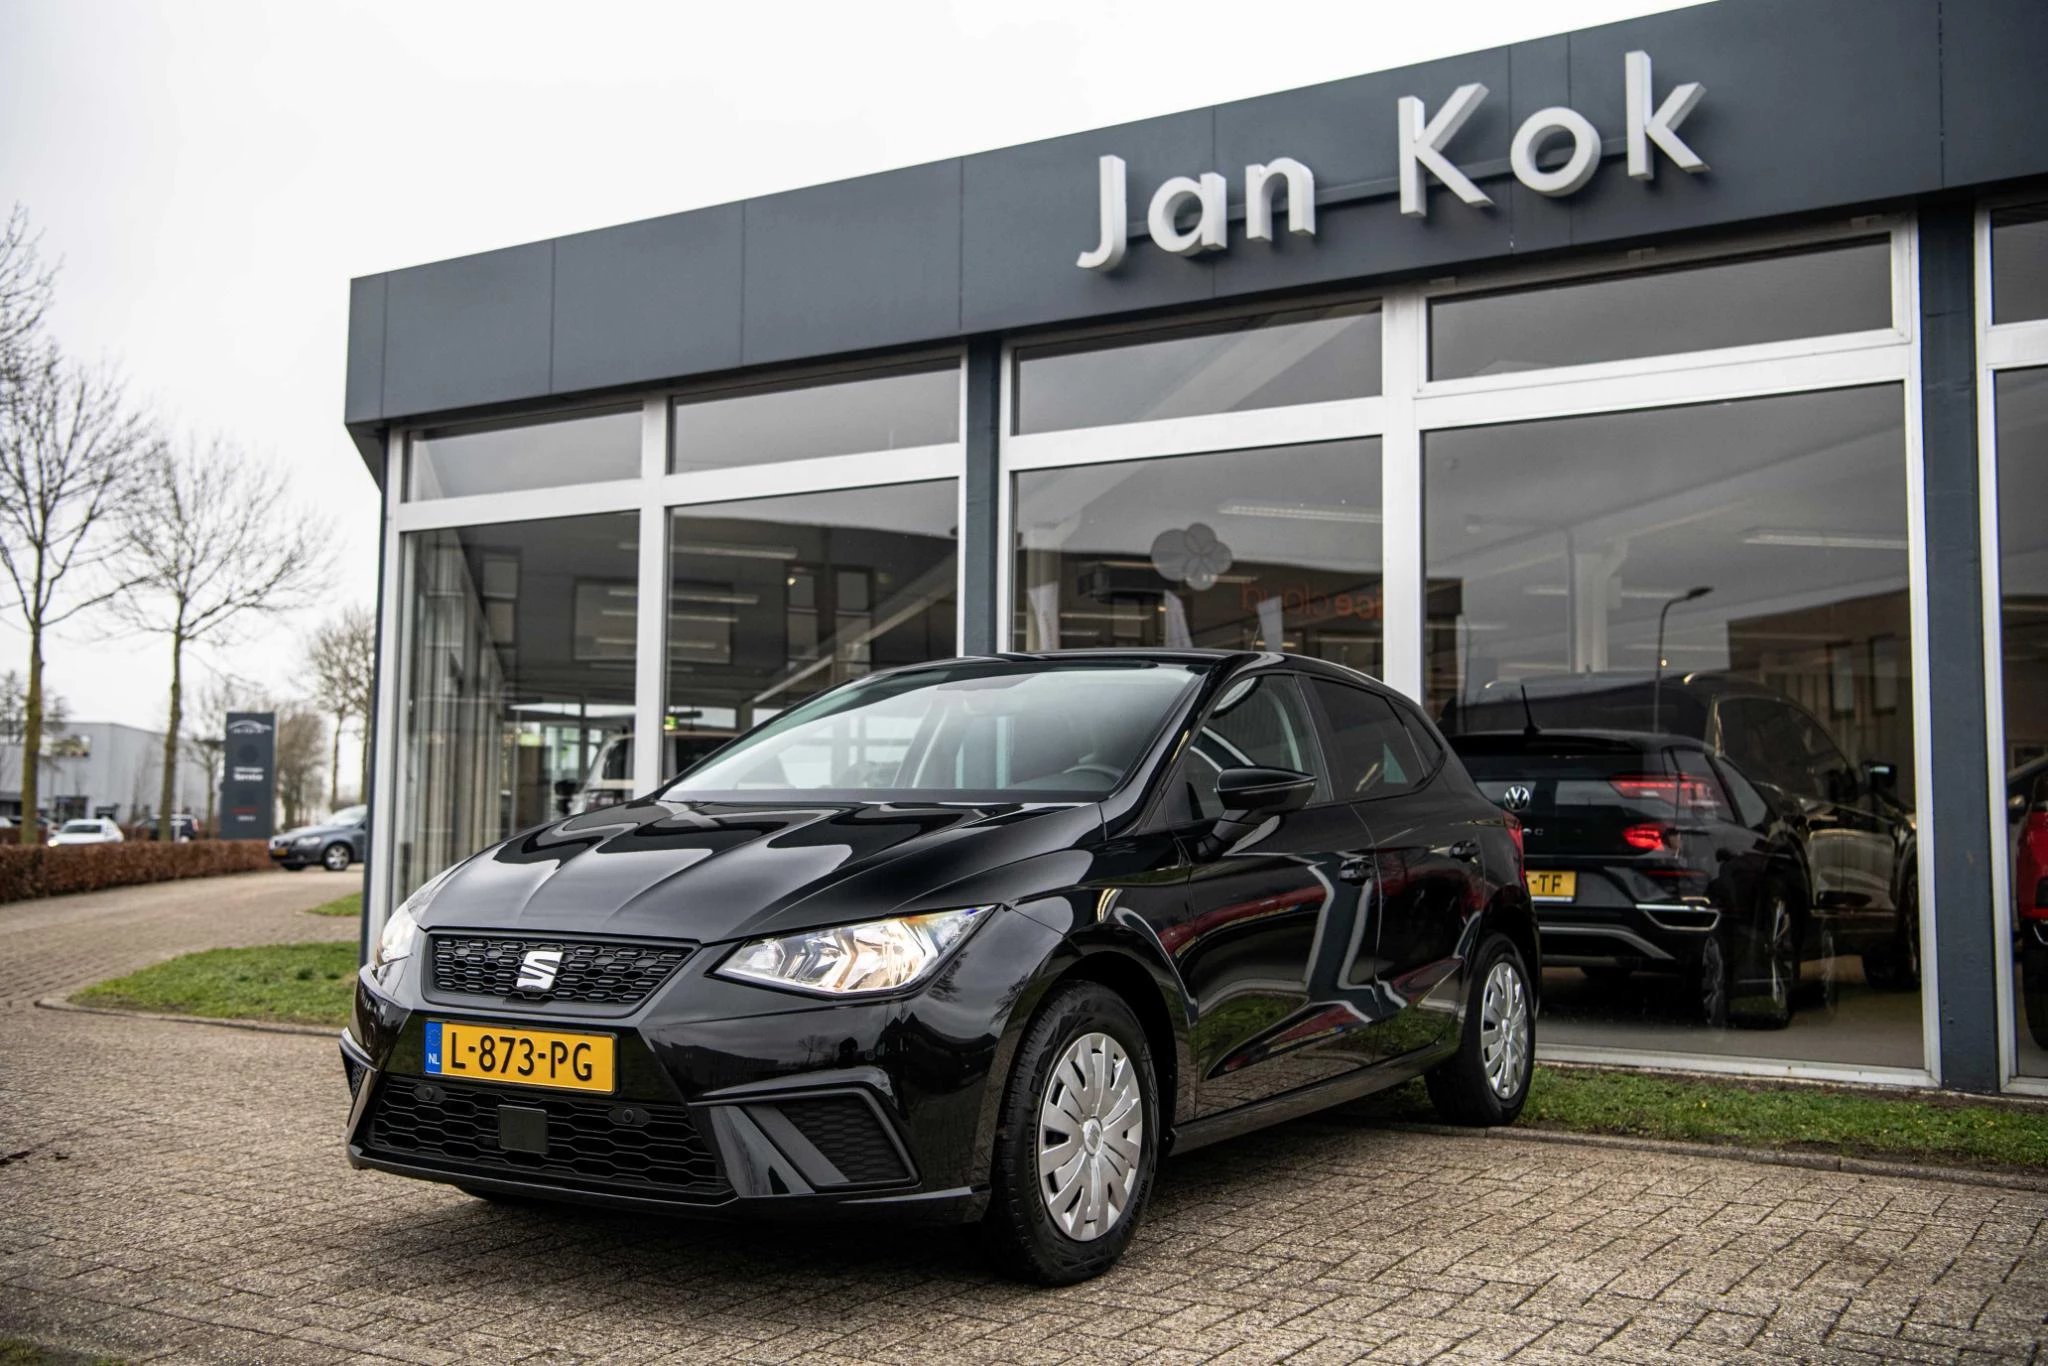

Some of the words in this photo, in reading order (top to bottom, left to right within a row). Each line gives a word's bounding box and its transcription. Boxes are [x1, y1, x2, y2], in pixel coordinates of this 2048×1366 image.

[1076, 154, 1316, 272] Jan
[1398, 50, 1711, 218] Kok
[428, 1053, 440, 1065] NL
[451, 1031, 592, 1082] L-873-PG
